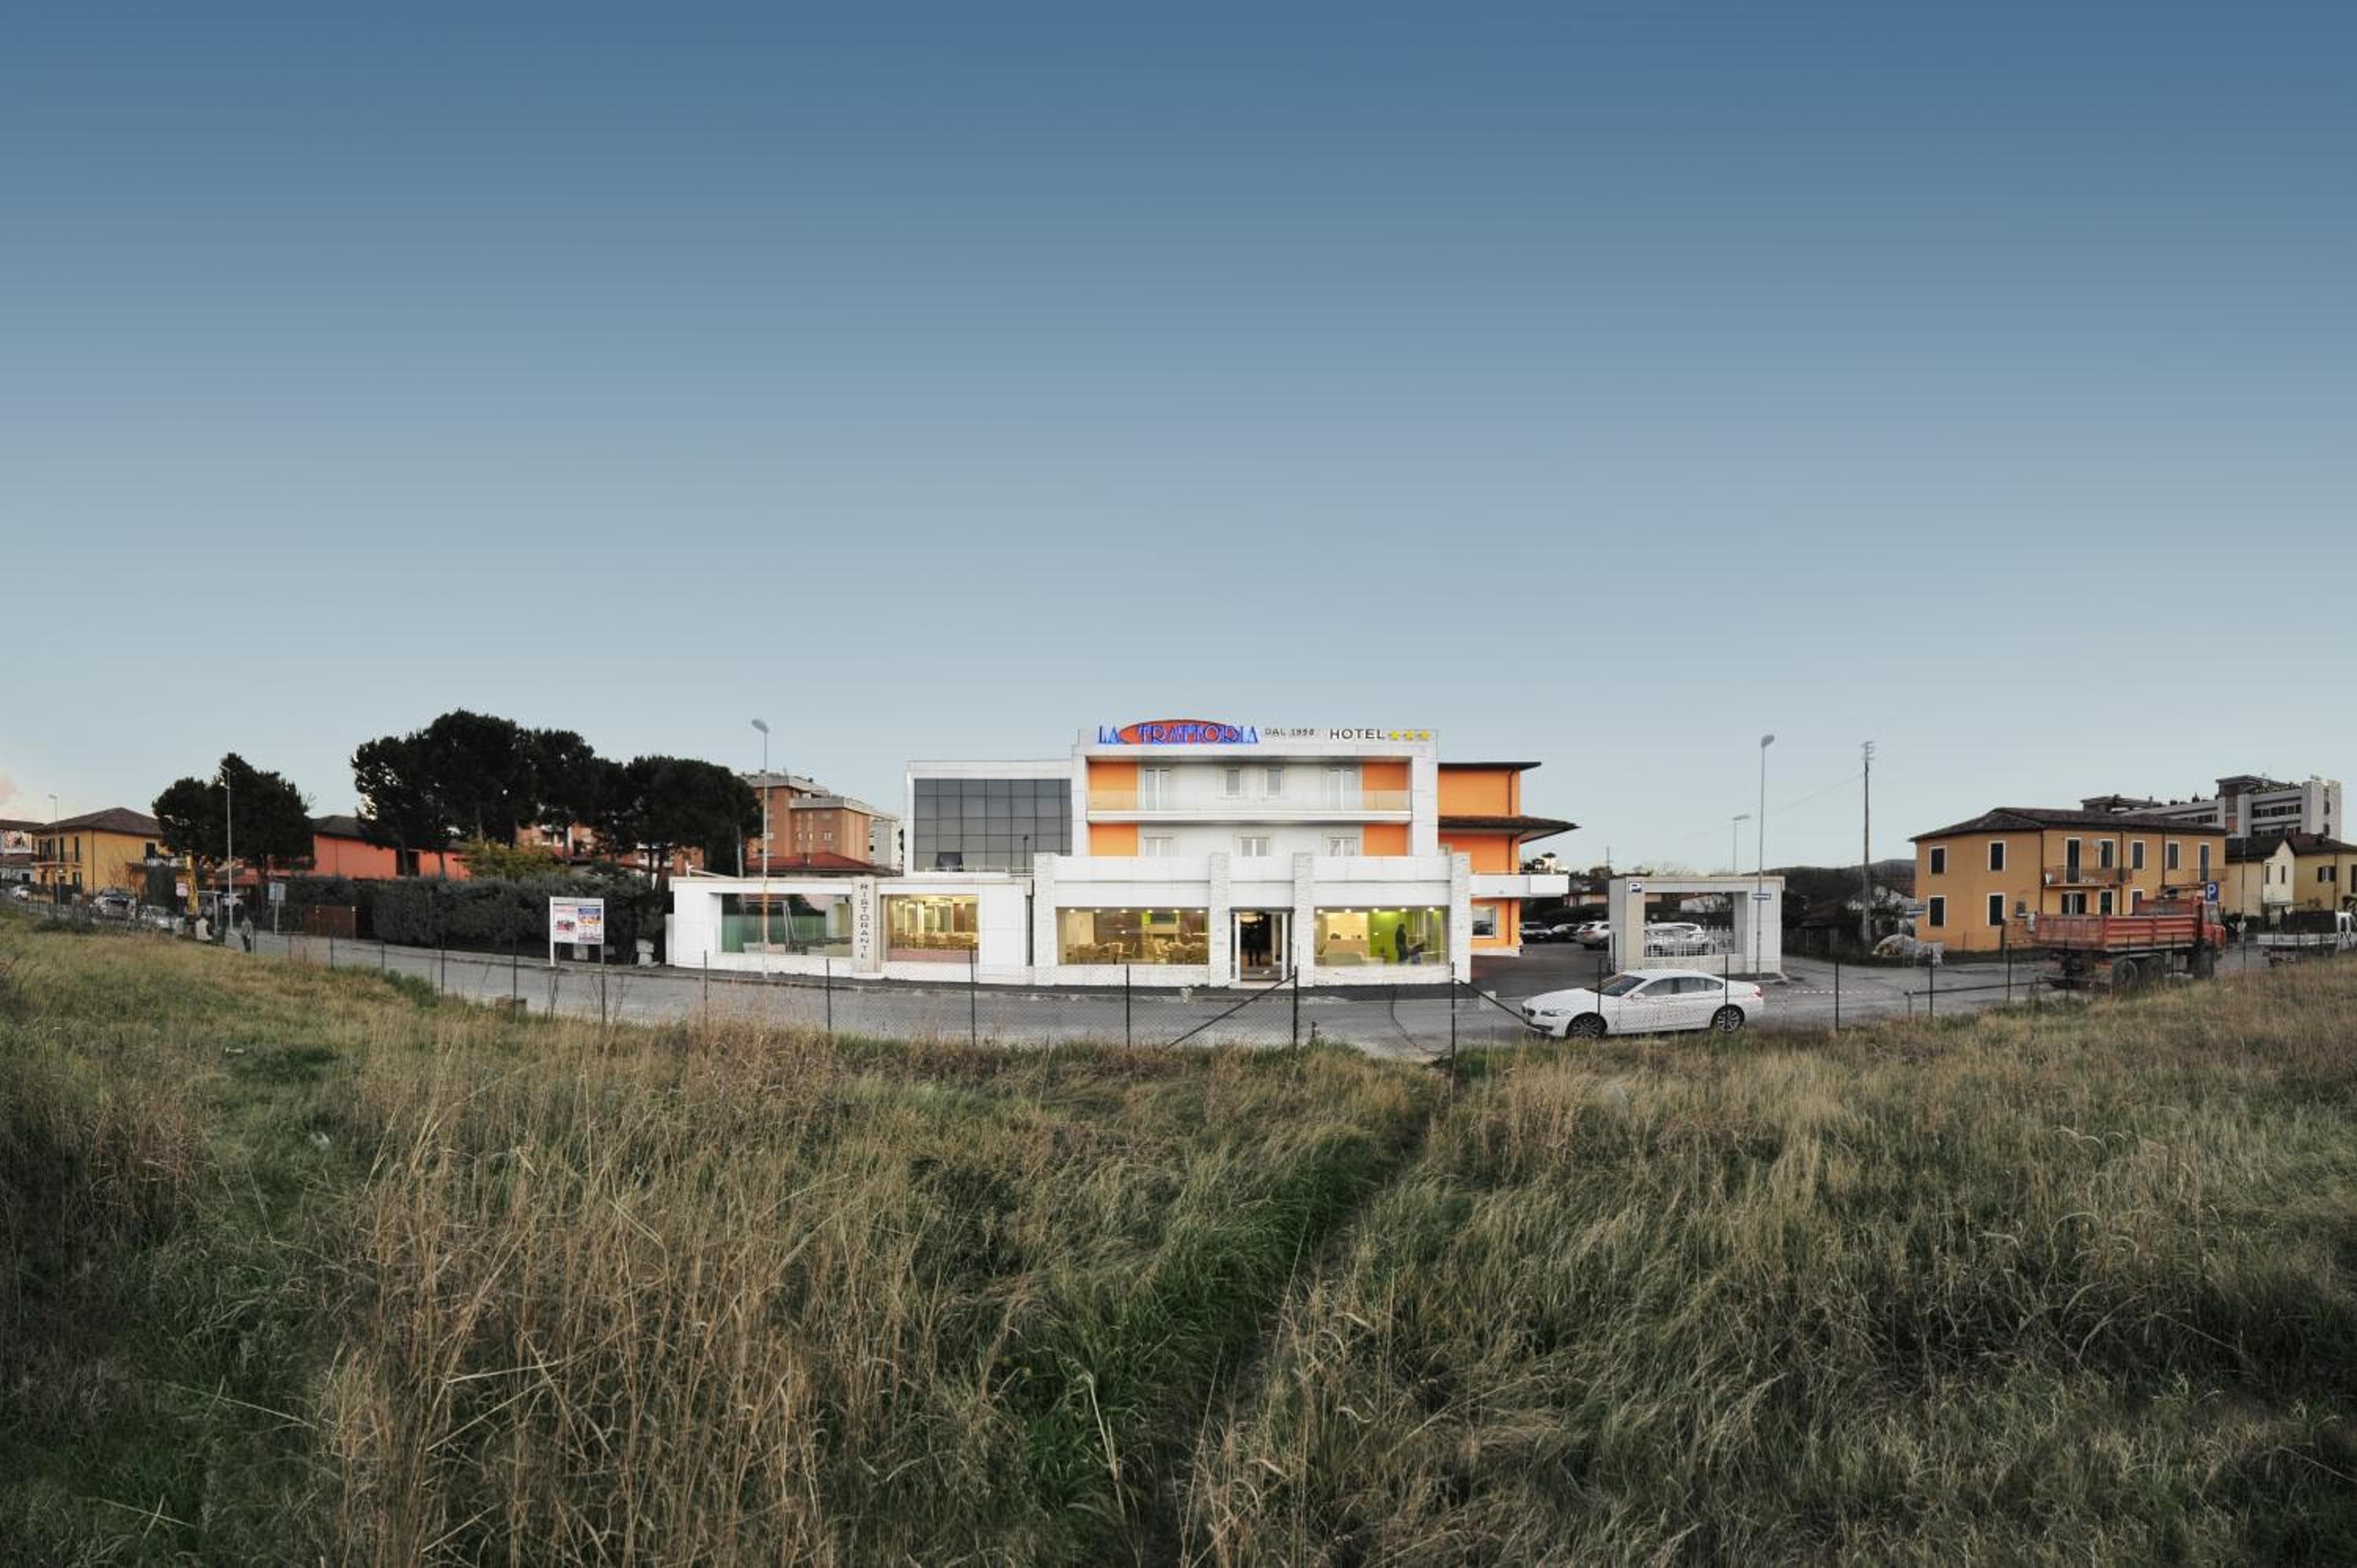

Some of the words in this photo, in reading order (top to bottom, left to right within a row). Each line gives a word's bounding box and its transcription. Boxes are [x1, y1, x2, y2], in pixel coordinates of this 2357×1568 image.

[1098, 725, 1120, 743] LA
[1138, 724, 1259, 744] TRATTORIA
[1329, 729, 1385, 739] HOTEL
[2208, 884, 2216, 899] P
[860, 883, 869, 959] RISTORANTE
